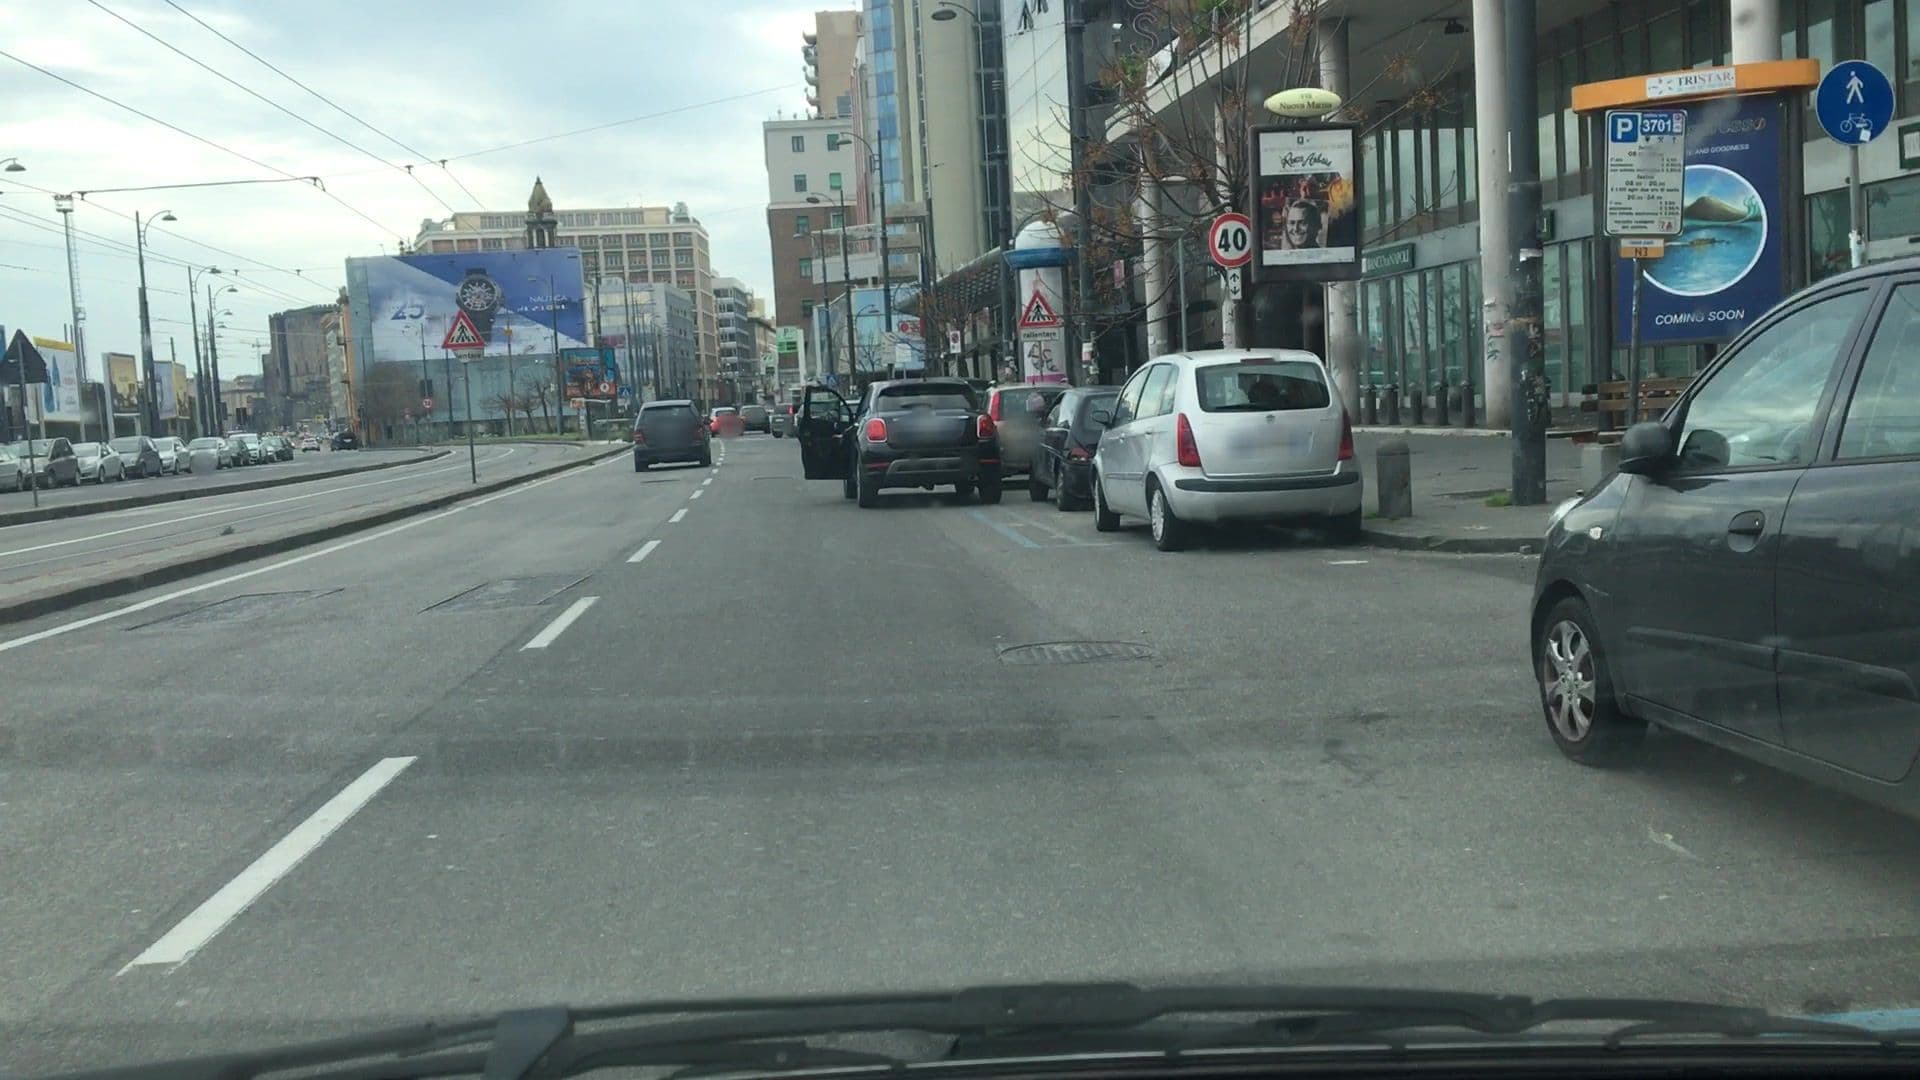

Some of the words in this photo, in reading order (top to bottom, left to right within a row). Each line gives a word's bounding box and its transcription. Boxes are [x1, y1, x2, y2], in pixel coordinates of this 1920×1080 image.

[1676, 71, 1731, 87] TRISTAR
[1617, 118, 1633, 140] P
[1642, 119, 1671, 132] 3701
[1711, 143, 1750, 154] GOODNESS
[1218, 227, 1247, 252] 40
[1634, 247, 1648, 257] N3
[528, 294, 568, 303] NAUTCA
[1655, 312, 1705, 325] COMING
[1707, 309, 1745, 322] SOON
[1022, 330, 1057, 339] rallentare
